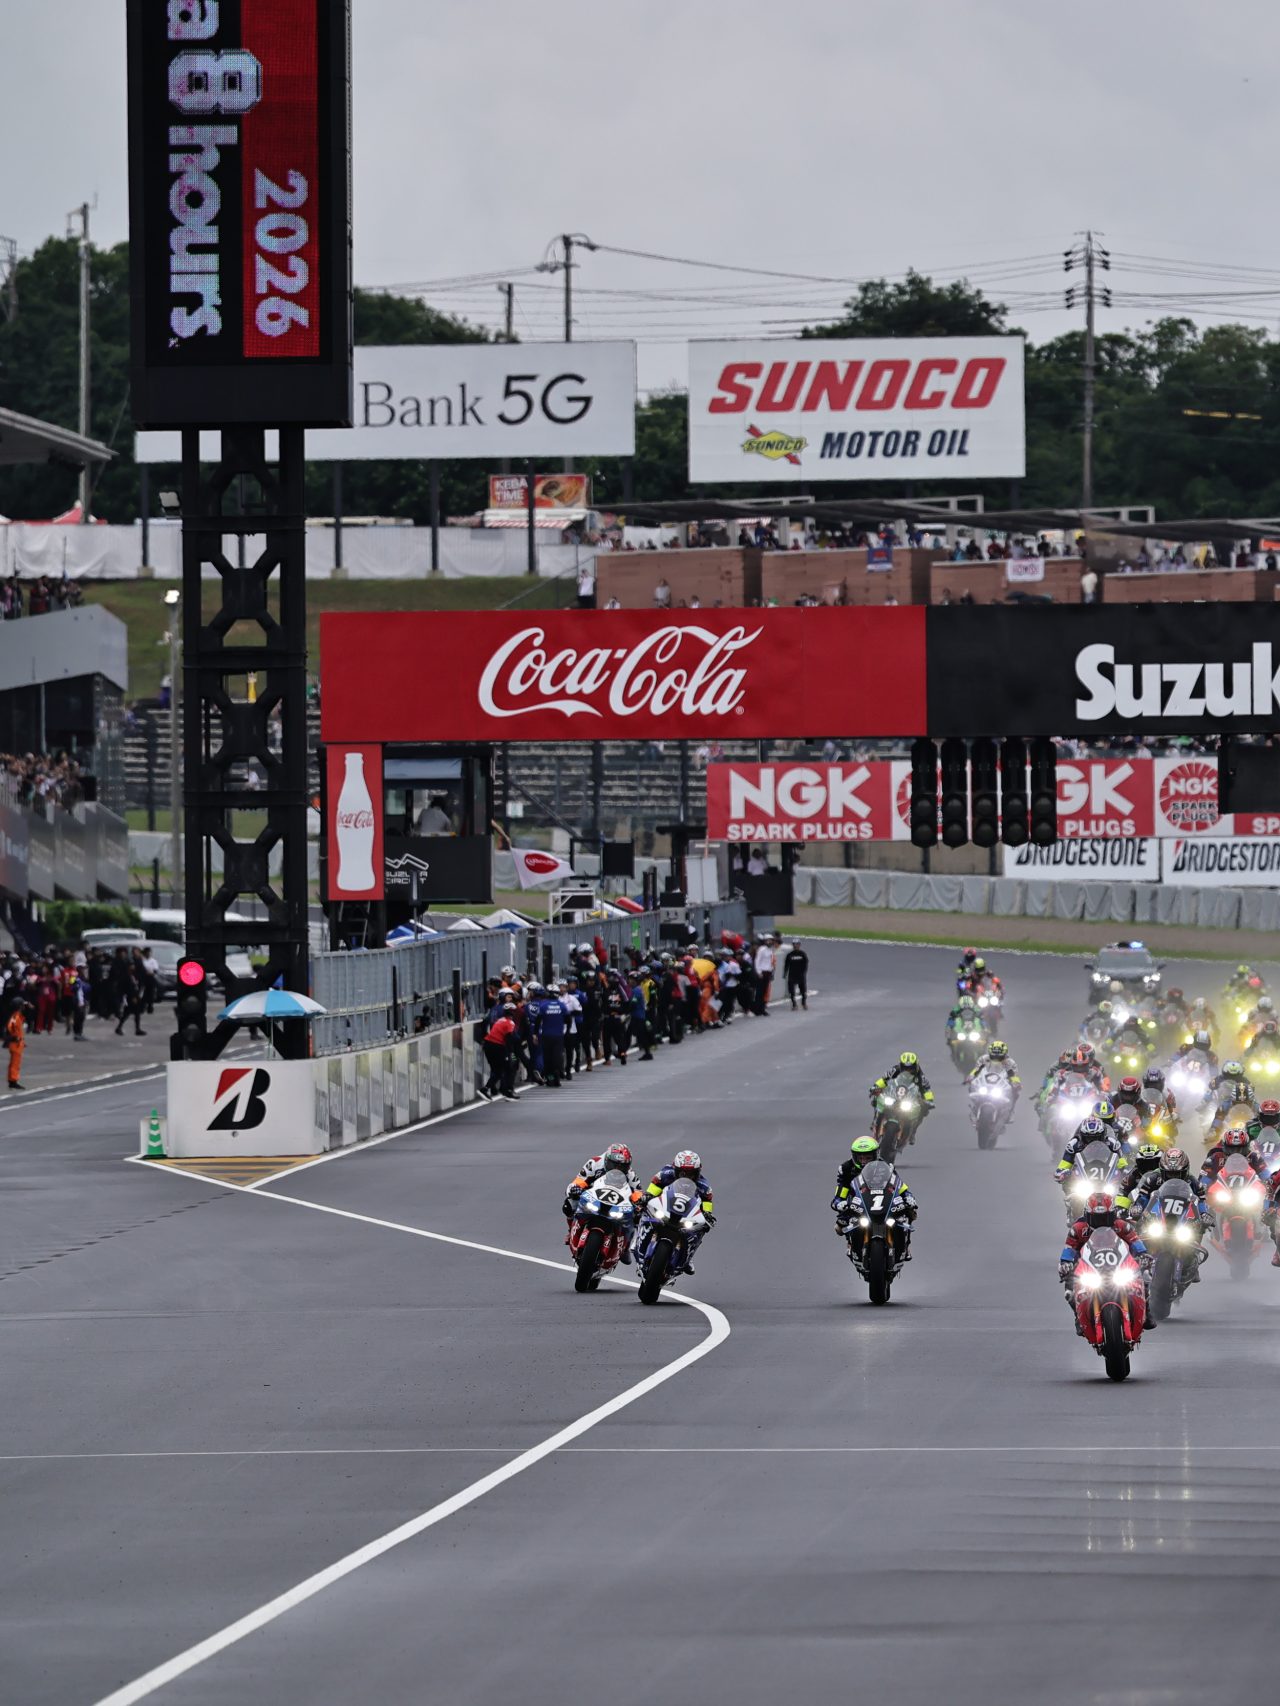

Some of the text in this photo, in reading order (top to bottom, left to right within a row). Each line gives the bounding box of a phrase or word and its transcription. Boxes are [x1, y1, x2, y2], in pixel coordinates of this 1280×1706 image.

[168, 49, 262, 115] 8
[168, 125, 238, 339] hours
[254, 168, 309, 337] 2026
[708, 357, 1007, 413] SUNOCO
[359, 373, 593, 428] Bank 5G
[744, 439, 804, 453] SUNOCO
[819, 429, 970, 459] MOTOR OIL
[495, 477, 529, 490] KEBA
[478, 625, 765, 717] Coca-Cola
[730, 765, 872, 819] NGK
[1056, 761, 1135, 816] GK
[1169, 776, 1218, 796] NGK
[1171, 801, 1218, 811] SPARK
[1172, 812, 1217, 822] PLUGS
[727, 821, 873, 840] SPARK PLUGS
[1065, 819, 1136, 836] PLUGS
[1015, 837, 1148, 867] BRIDGESTONE
[1089, 1167, 1104, 1180] 21
[599, 1188, 620, 1204] 73
[870, 1195, 884, 1211] 1
[673, 1199, 687, 1213] 5
[1164, 1198, 1184, 1215] 76
[1094, 1252, 1118, 1267] 30
